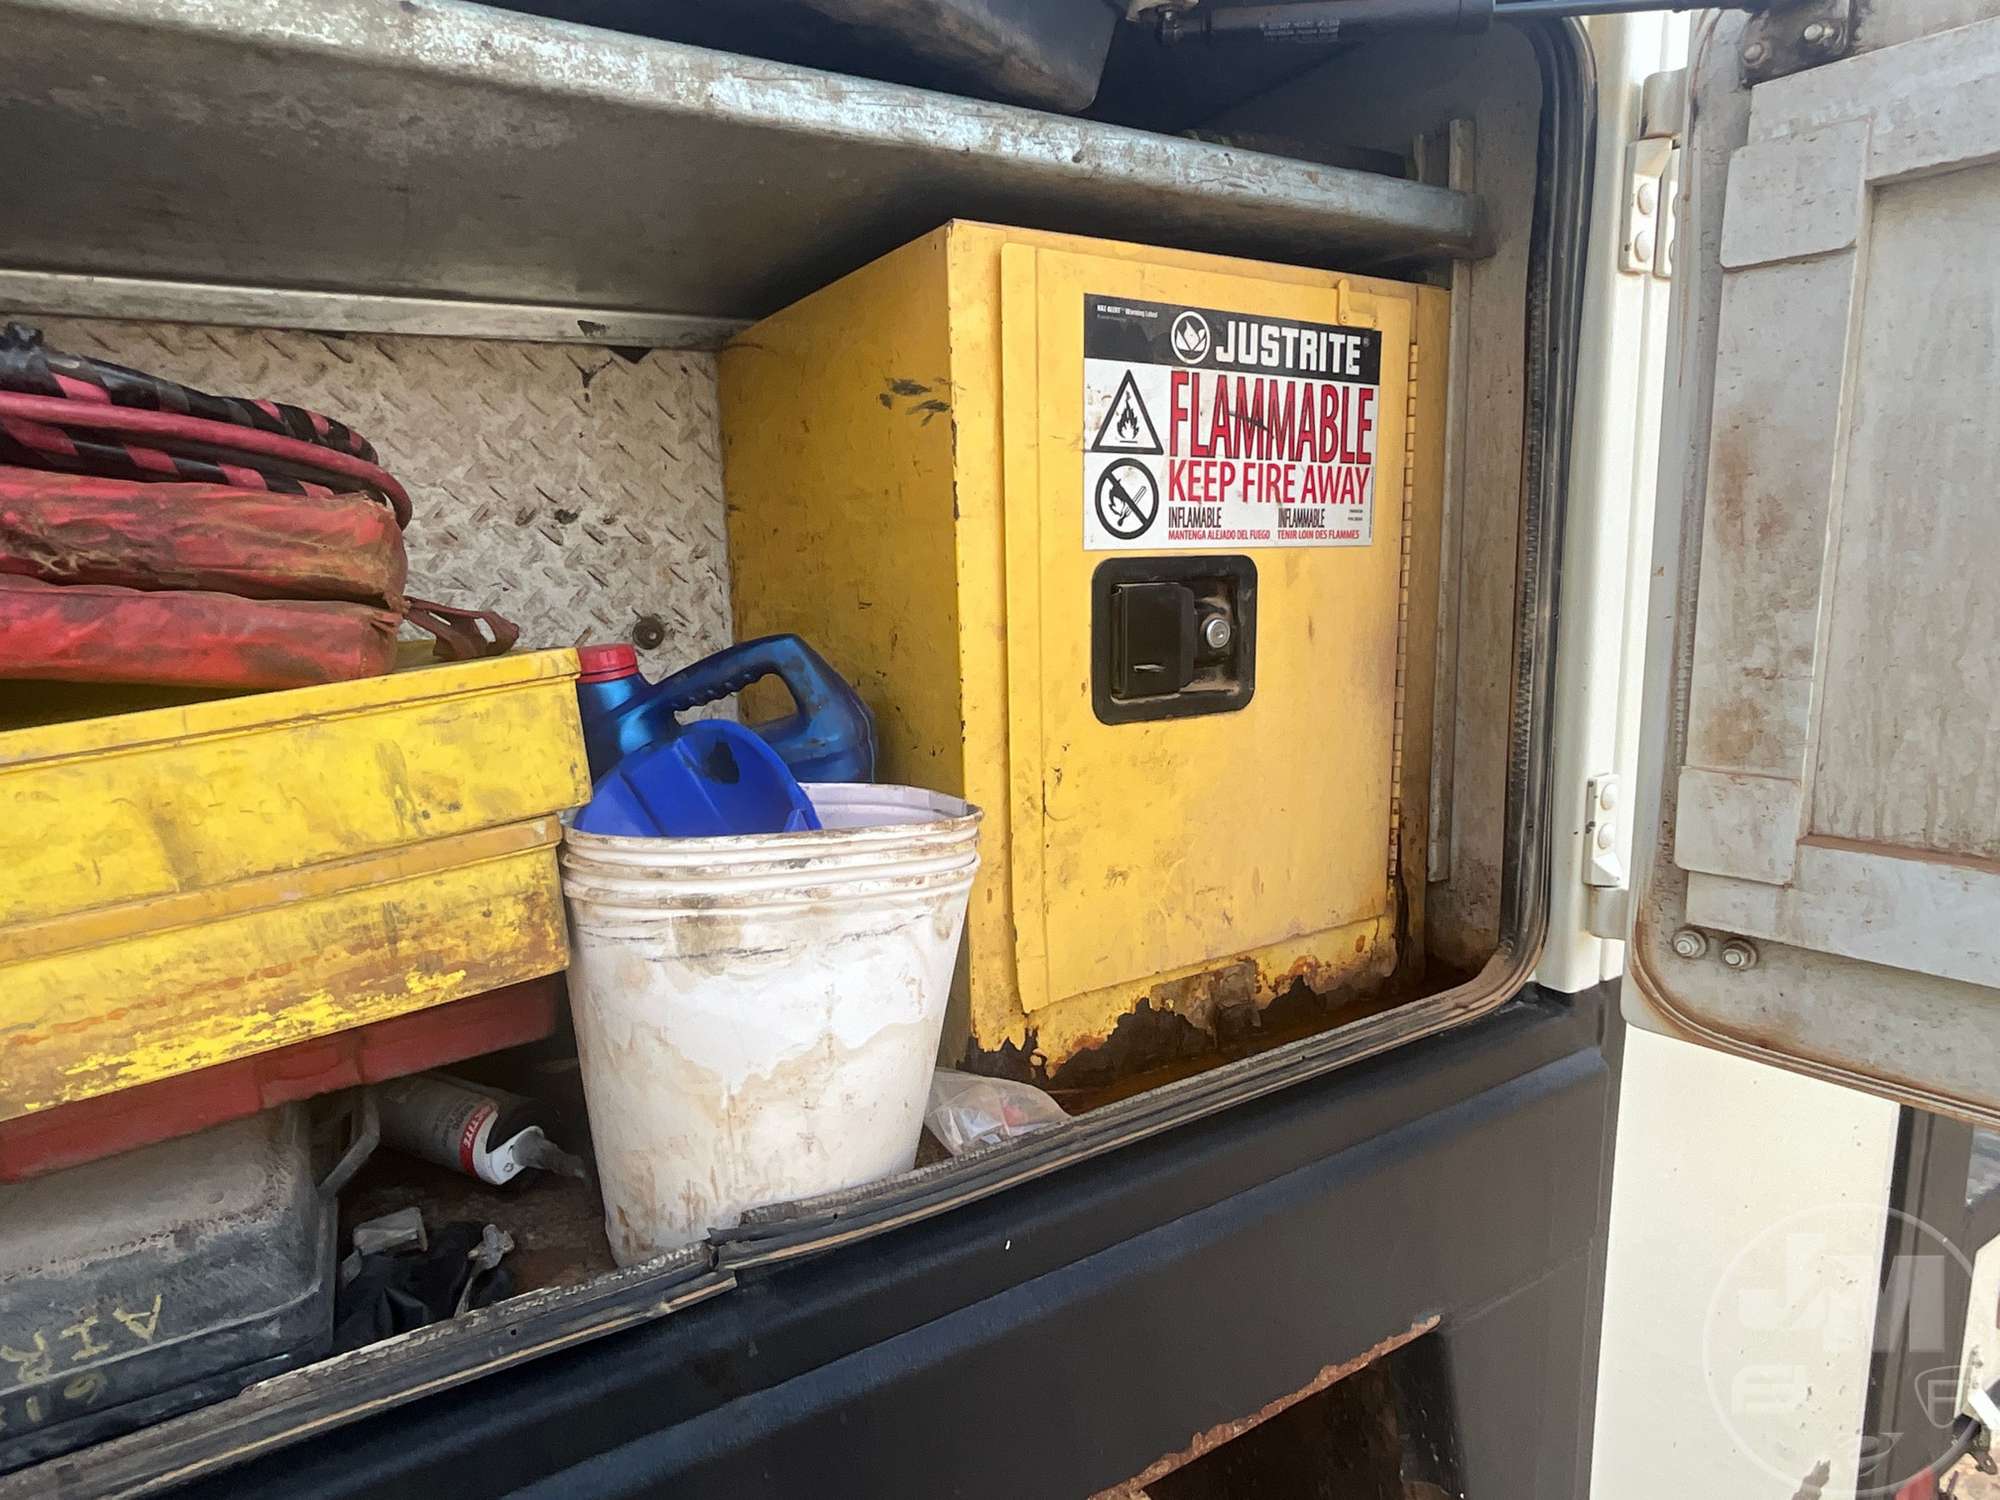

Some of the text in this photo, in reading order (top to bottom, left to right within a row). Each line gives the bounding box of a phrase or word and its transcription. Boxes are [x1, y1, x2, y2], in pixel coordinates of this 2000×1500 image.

[1169, 369, 1375, 465] FLAMMABLE
[1168, 459, 1371, 505] KEEP FIRE AWAY
[1168, 507, 1222, 529] INFLAMABLE
[1278, 507, 1325, 529] INFLAMMABLE
[1168, 529, 1271, 541] MANTENGA ALEJADO DEL FUEGO
[1278, 529, 1360, 540] TENIR LOIN DES FLAMMES
[0, 1294, 163, 1385] AIR
